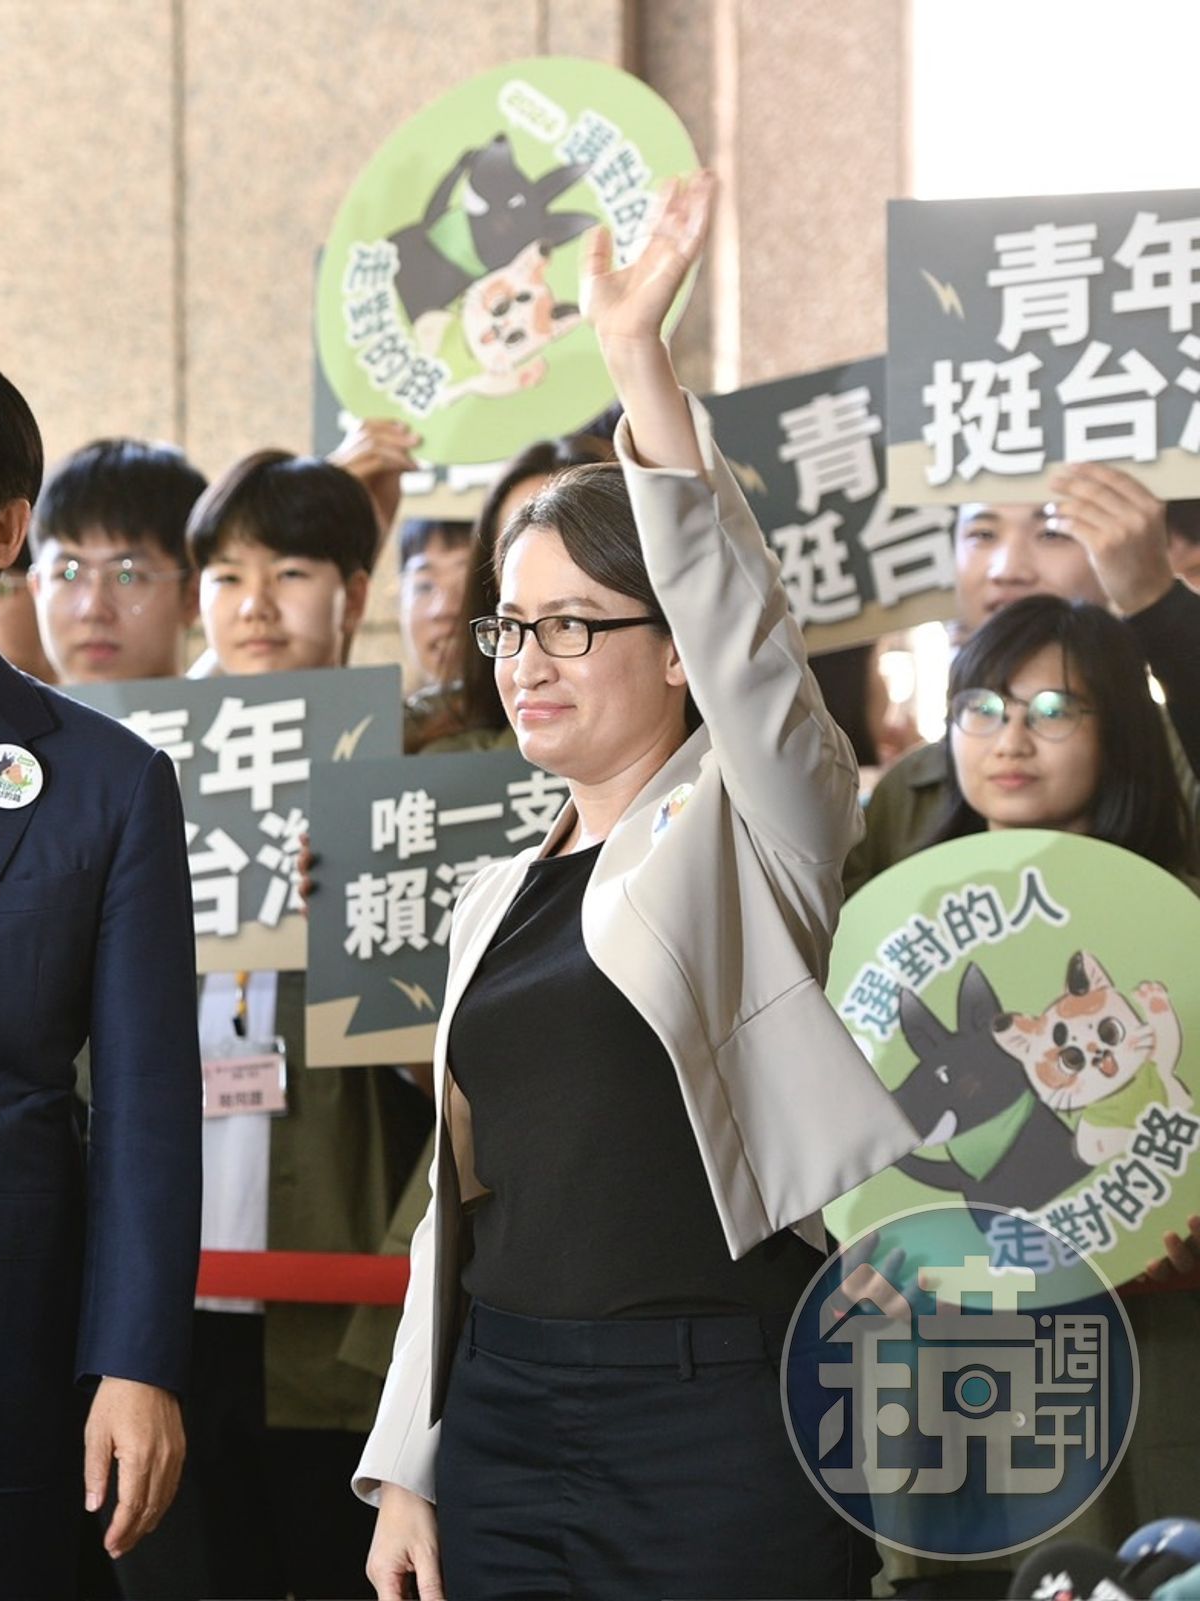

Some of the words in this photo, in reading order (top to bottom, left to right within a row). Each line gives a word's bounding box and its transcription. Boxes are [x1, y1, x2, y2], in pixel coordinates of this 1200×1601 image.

[563, 116, 649, 265] 選對的
[347, 246, 445, 411] 走對的路
[922, 334, 1200, 487] 挺台
[845, 871, 1064, 1037] 選對的人
[991, 1106, 1198, 1272] 走對的路
